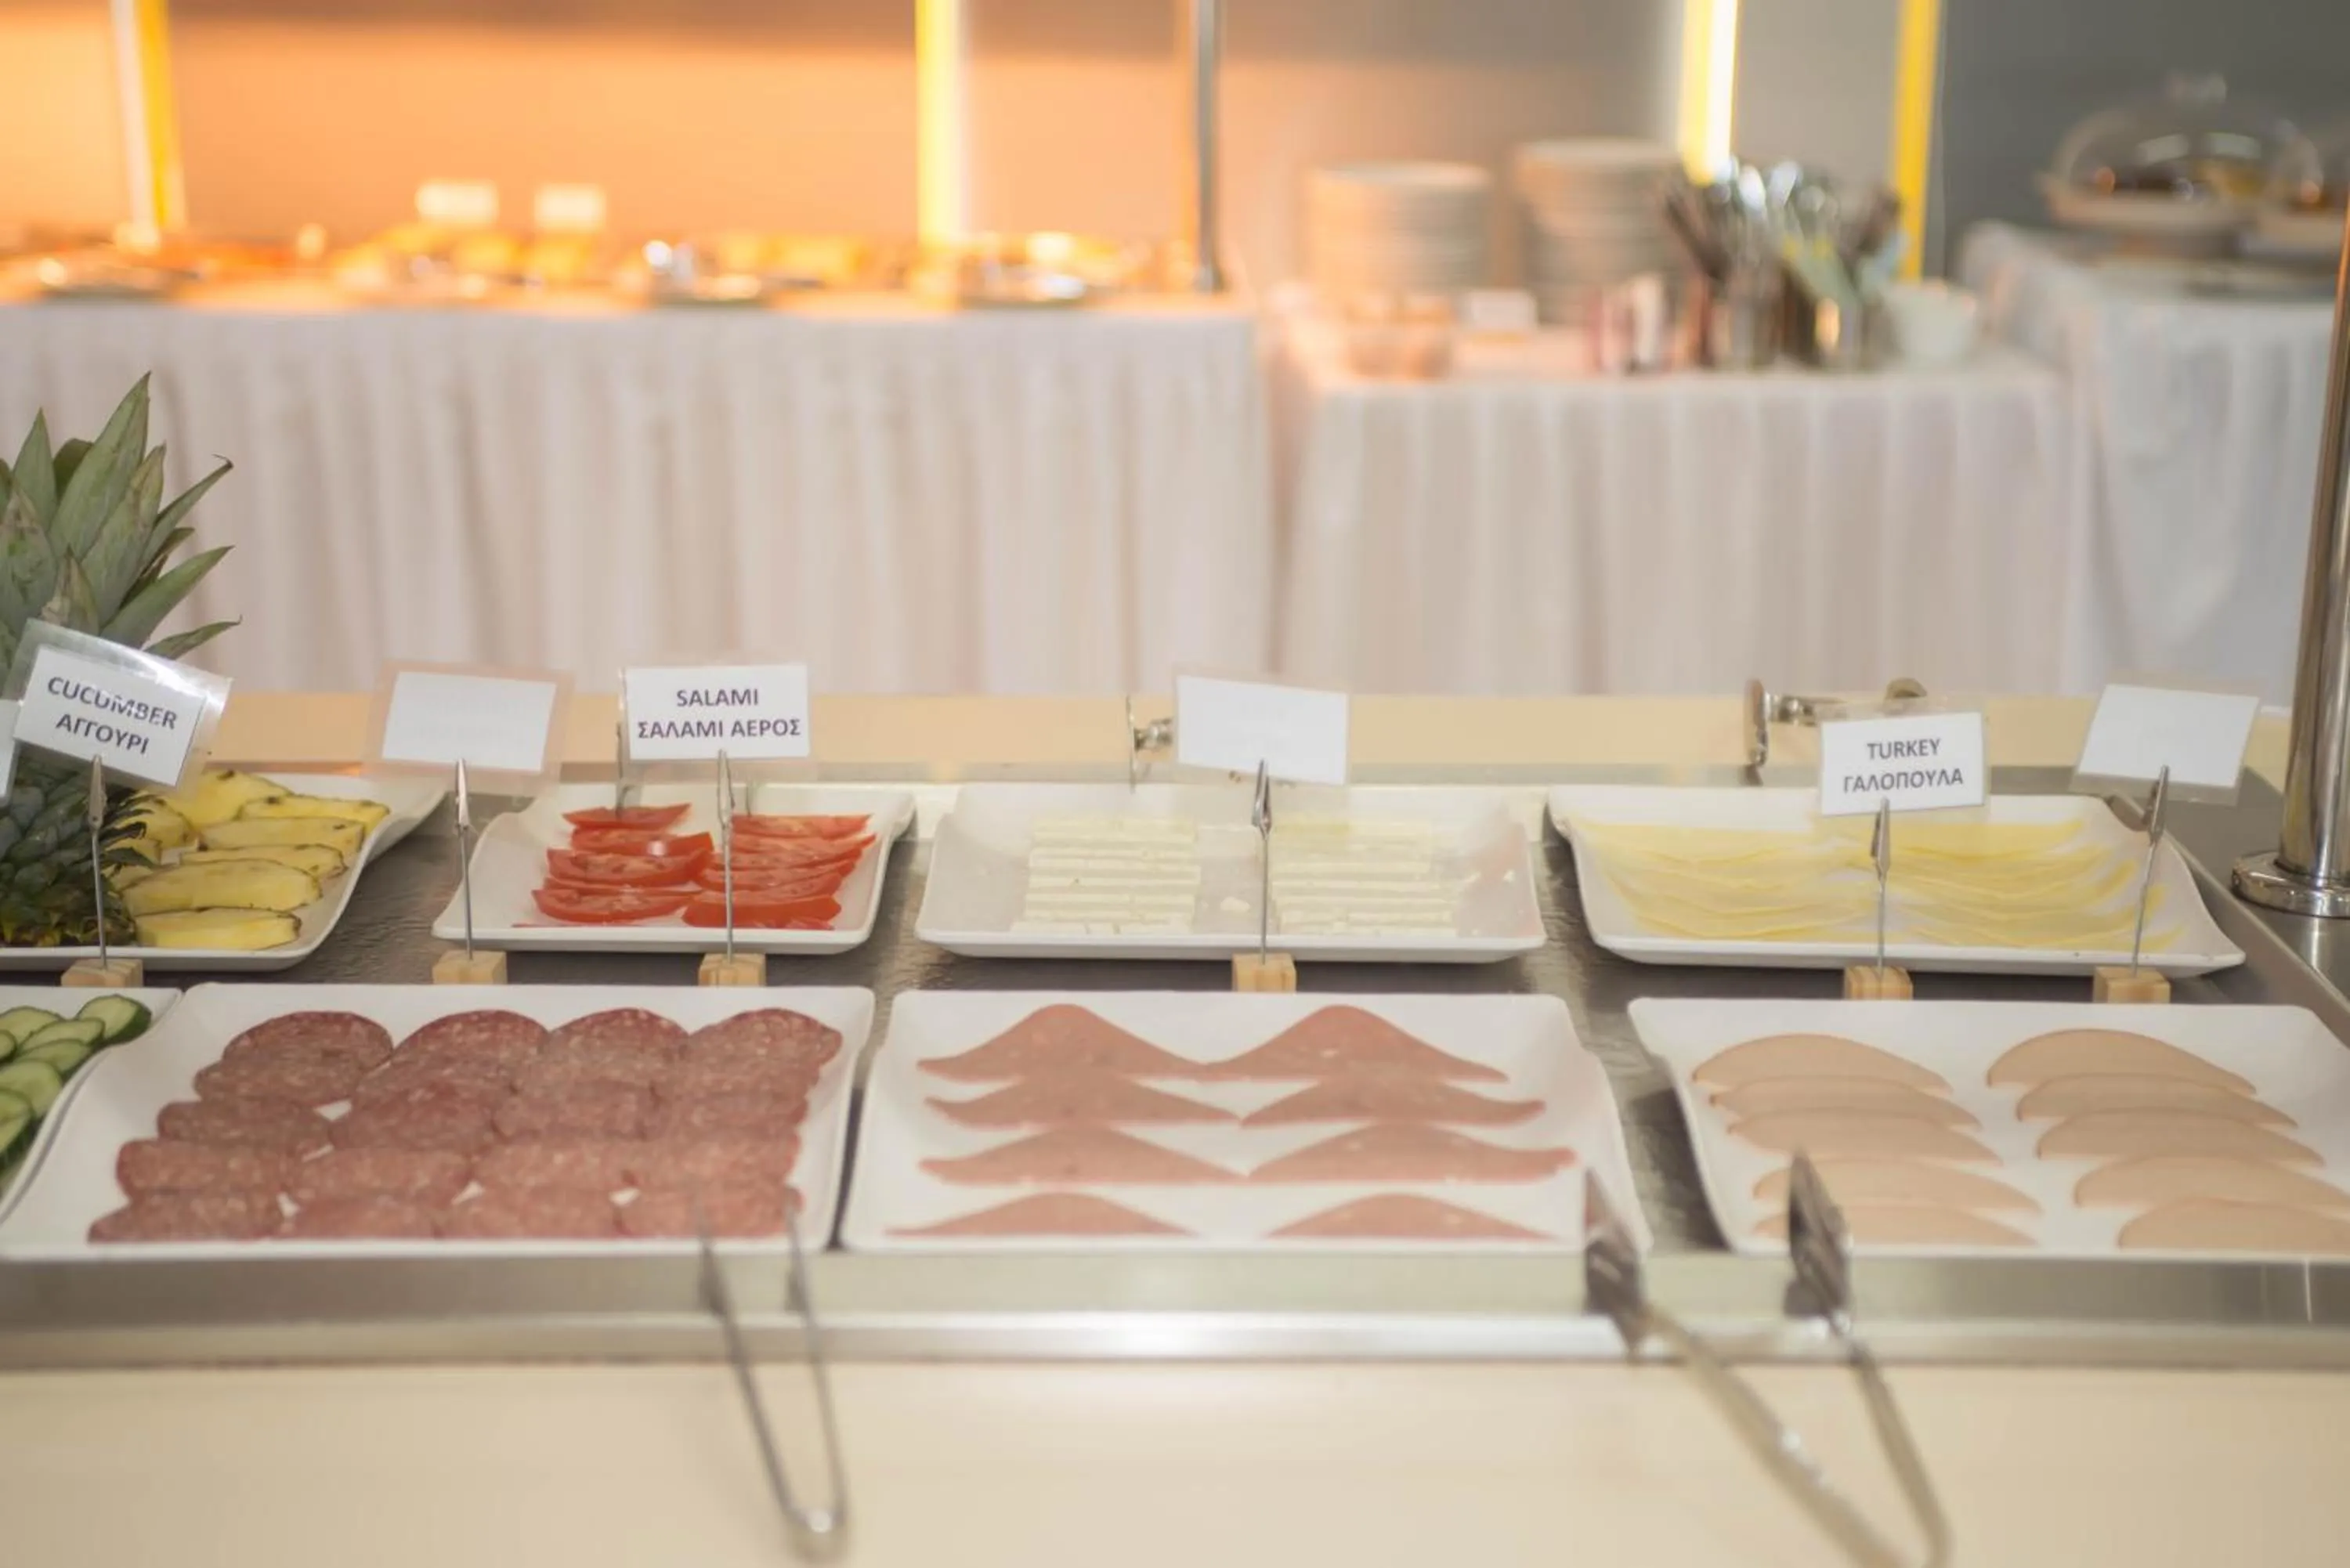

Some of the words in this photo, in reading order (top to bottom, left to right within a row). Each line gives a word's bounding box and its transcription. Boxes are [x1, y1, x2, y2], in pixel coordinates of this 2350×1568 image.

[48, 676, 177, 730] CUCUMBER
[677, 688, 758, 706] SALAMI
[56, 714, 150, 754] ΑΓΓΟΥΡΙ
[638, 720, 723, 739] ΣΑΛΑΜΙ
[731, 718, 801, 737] ΑΕΡΟΣ
[1867, 738, 1941, 760] TURKEY
[1843, 768, 1964, 793] ΓΑΛΟΠΟΥΛΑ
